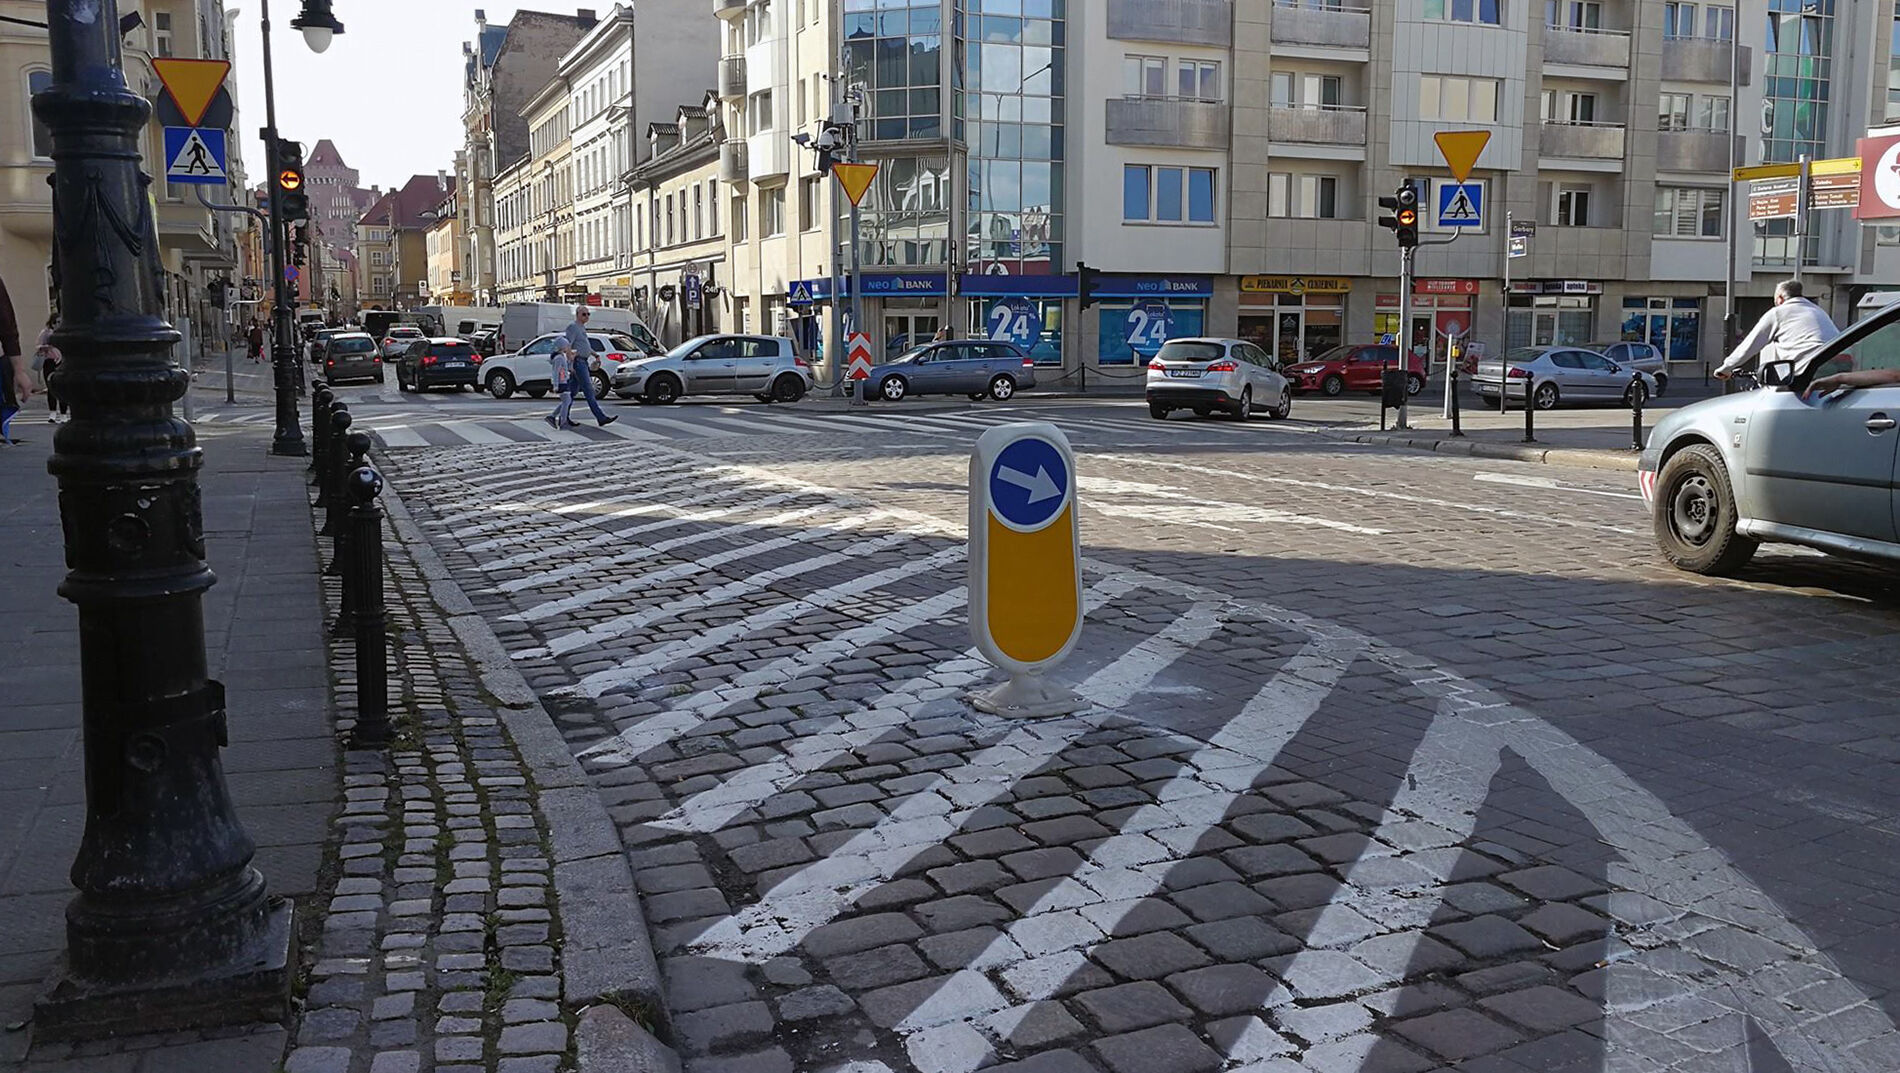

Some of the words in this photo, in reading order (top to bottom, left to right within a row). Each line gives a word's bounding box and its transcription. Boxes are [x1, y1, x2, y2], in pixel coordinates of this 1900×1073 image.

[1513, 225, 1534, 233] Garbary
[906, 280, 933, 289] BANK
[1172, 282, 1198, 290] BANK
[1257, 279, 1288, 289] PIEKARNIA
[1566, 283, 1585, 291] apteka
[689, 290, 697, 301] P
